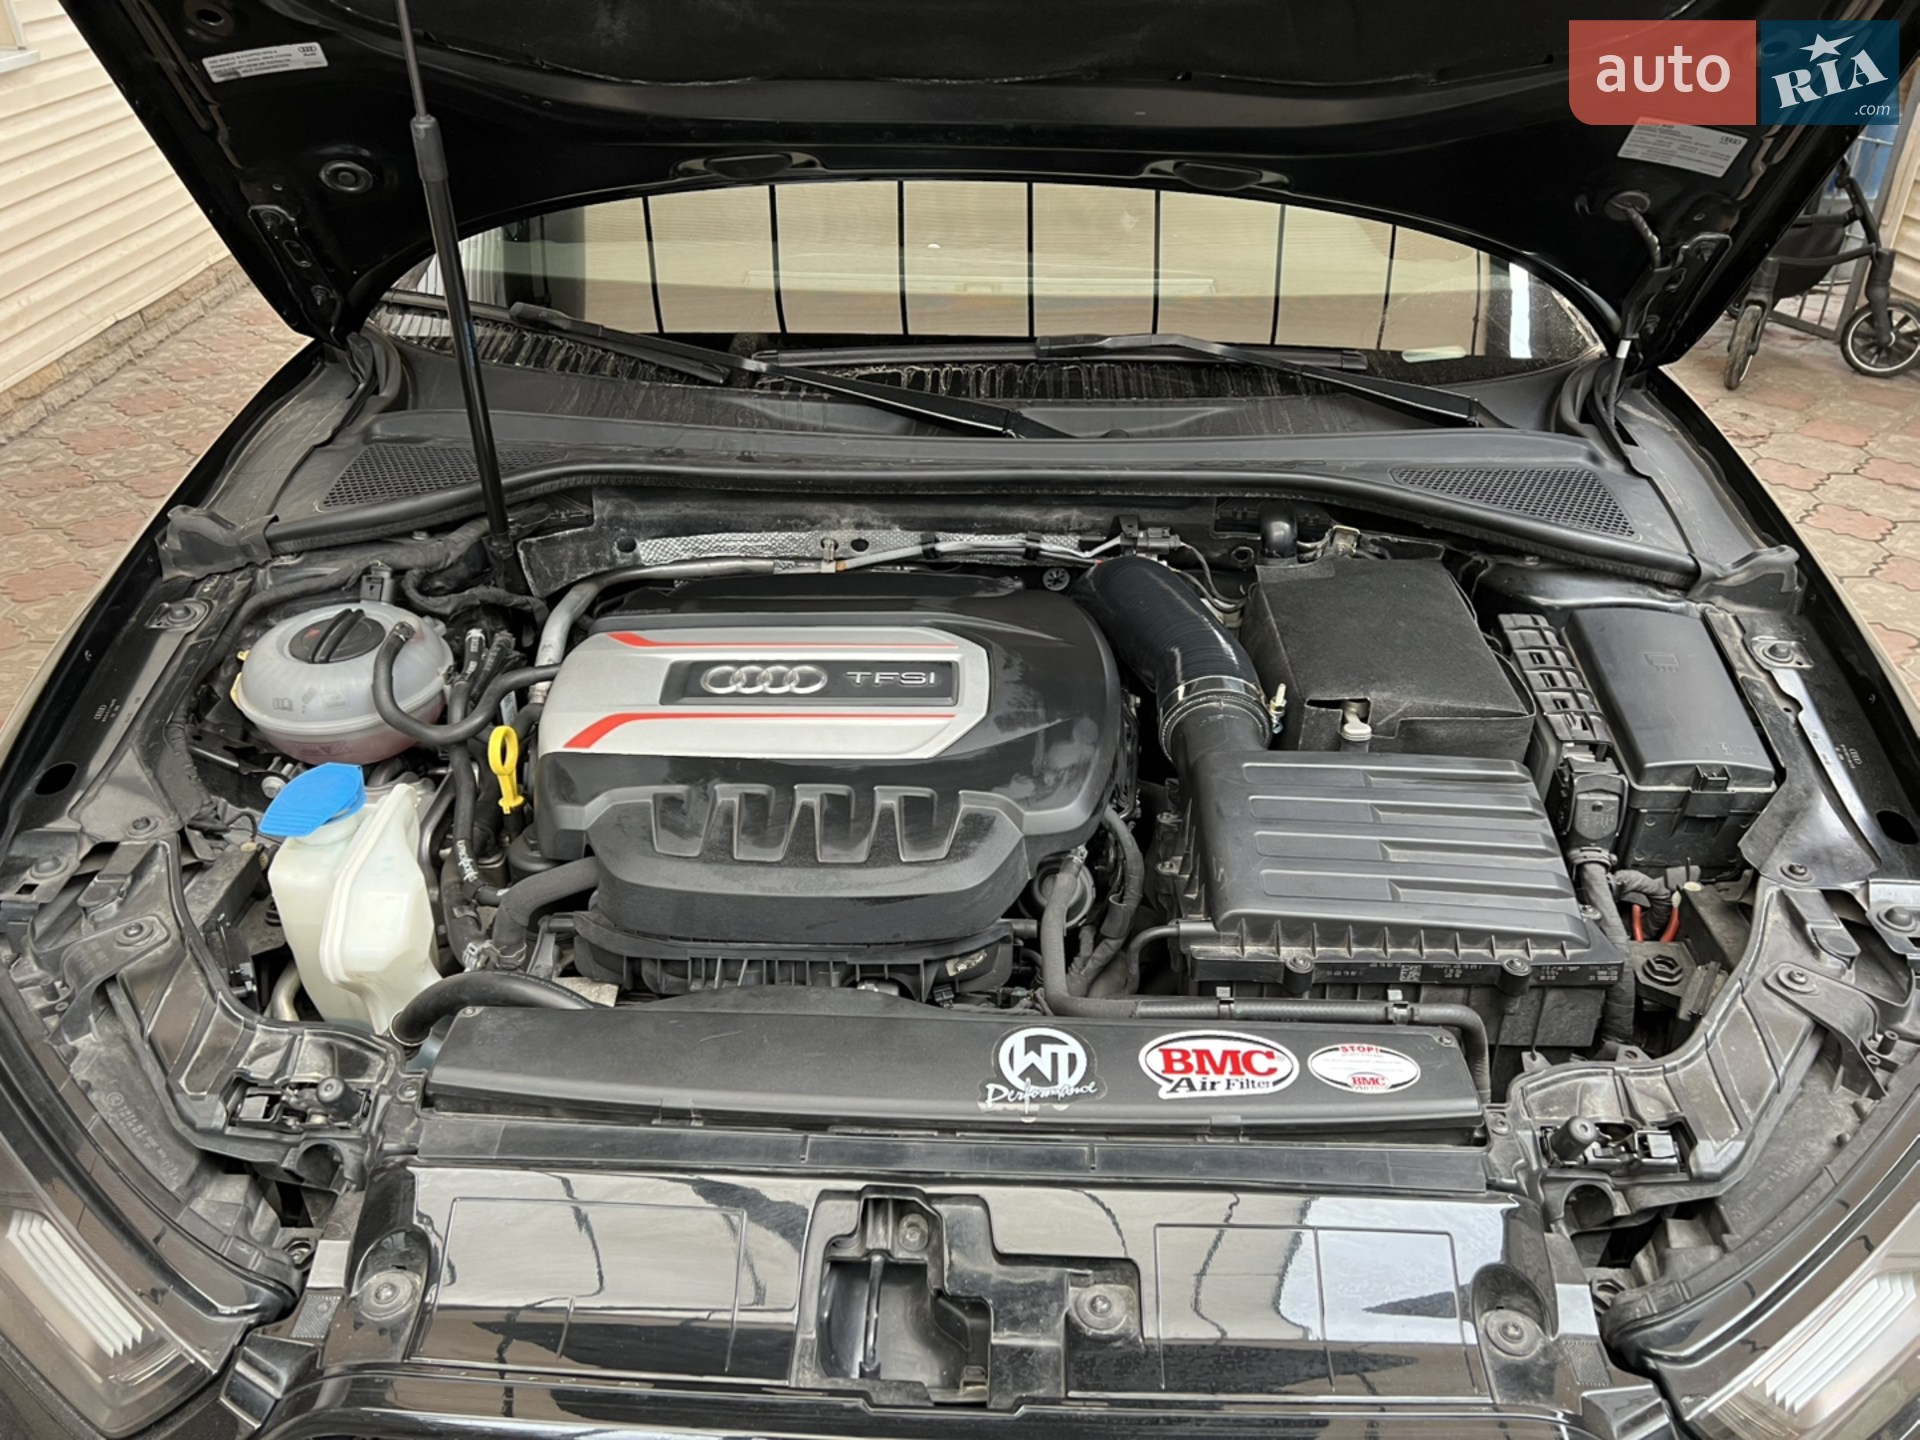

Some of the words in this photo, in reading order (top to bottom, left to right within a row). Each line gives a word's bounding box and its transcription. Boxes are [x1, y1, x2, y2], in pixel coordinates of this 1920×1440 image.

[846, 671, 935, 684] TFSI
[1340, 1045, 1380, 1053] STOP!
[1158, 1048, 1278, 1077] BMC
[1166, 1077, 1220, 1093] Air
[1226, 1079, 1270, 1090] Filter
[1351, 1077, 1386, 1086] BMC
[985, 1078, 1098, 1114] Performance
